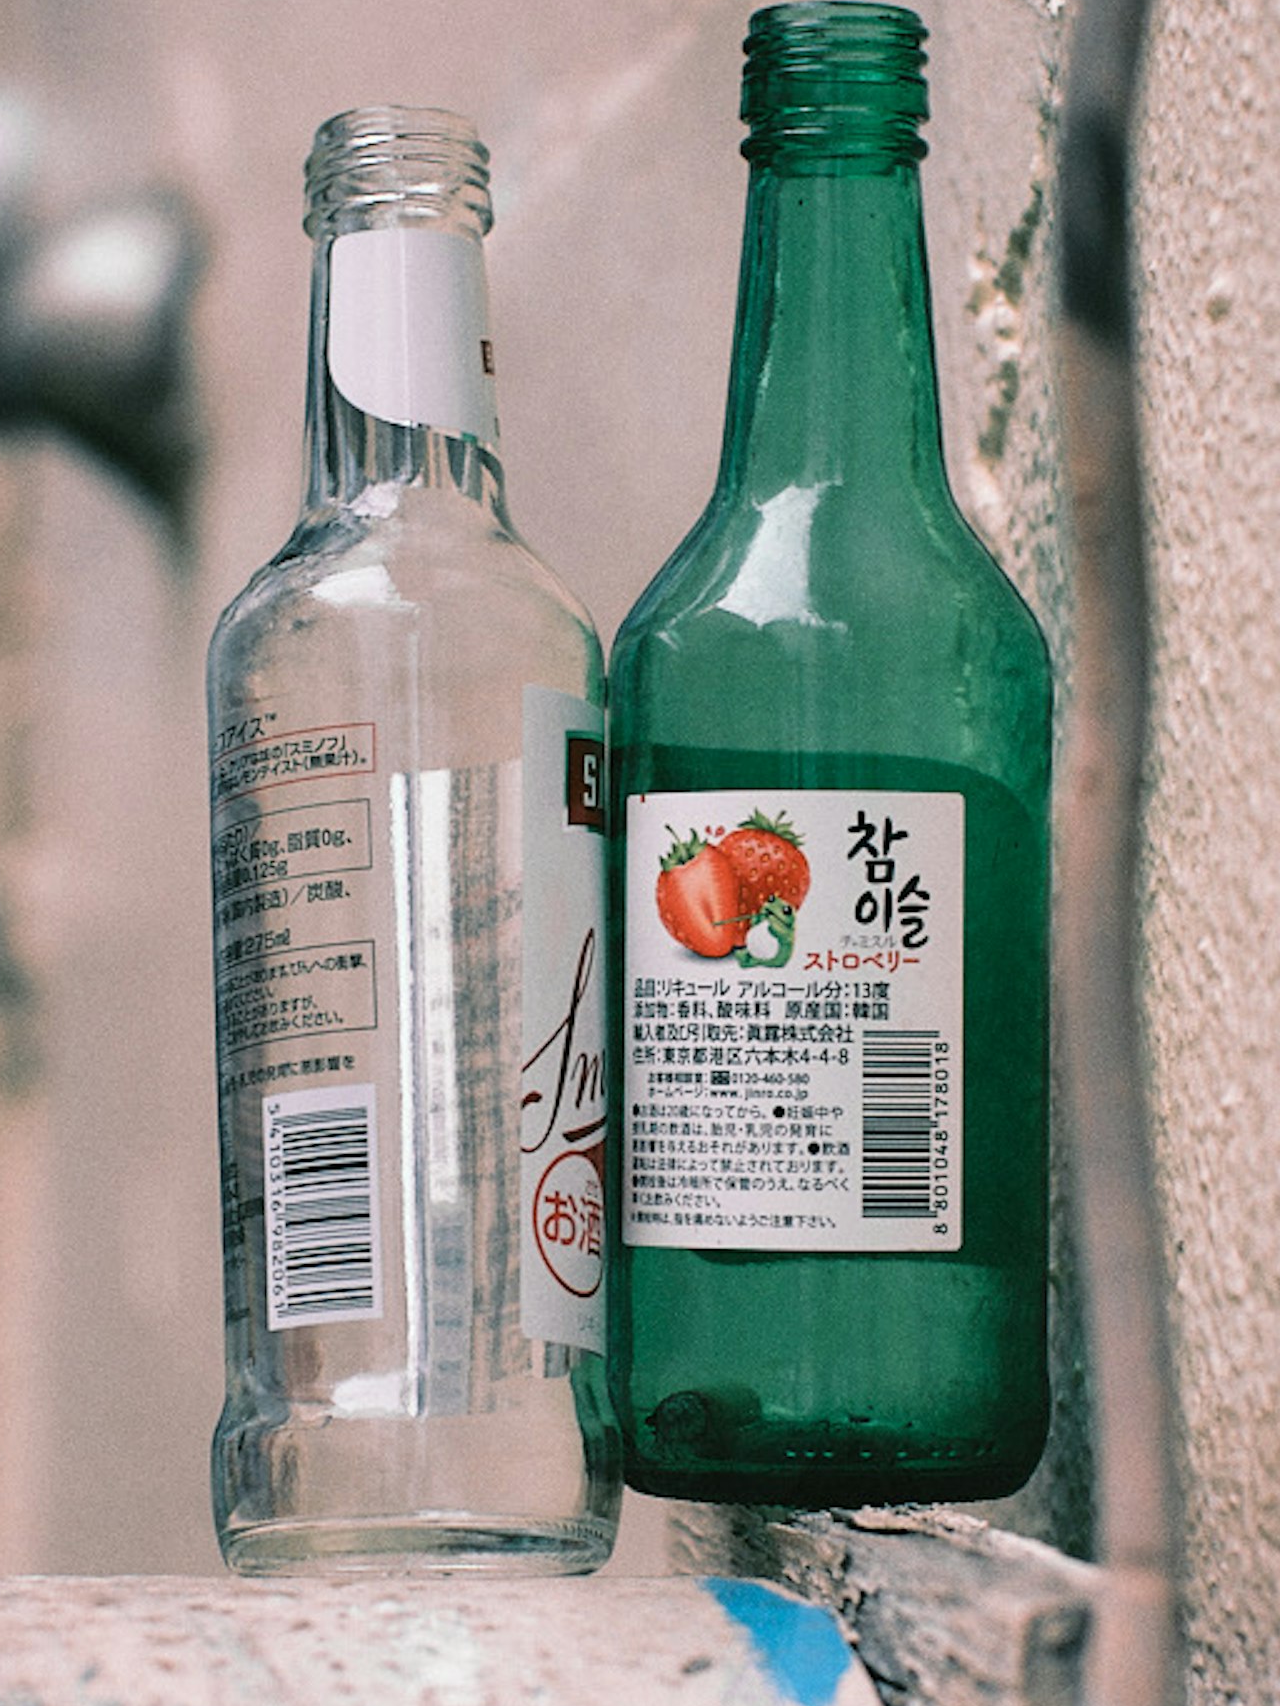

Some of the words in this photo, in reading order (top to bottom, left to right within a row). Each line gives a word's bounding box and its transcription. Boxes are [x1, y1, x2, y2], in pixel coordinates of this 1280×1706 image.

[847, 810, 909, 885] 참
[803, 949, 922, 973] ストロベリー
[737, 979, 890, 1001] アルコール分:13度
[784, 1001, 889, 1021] 原産国:韓国
